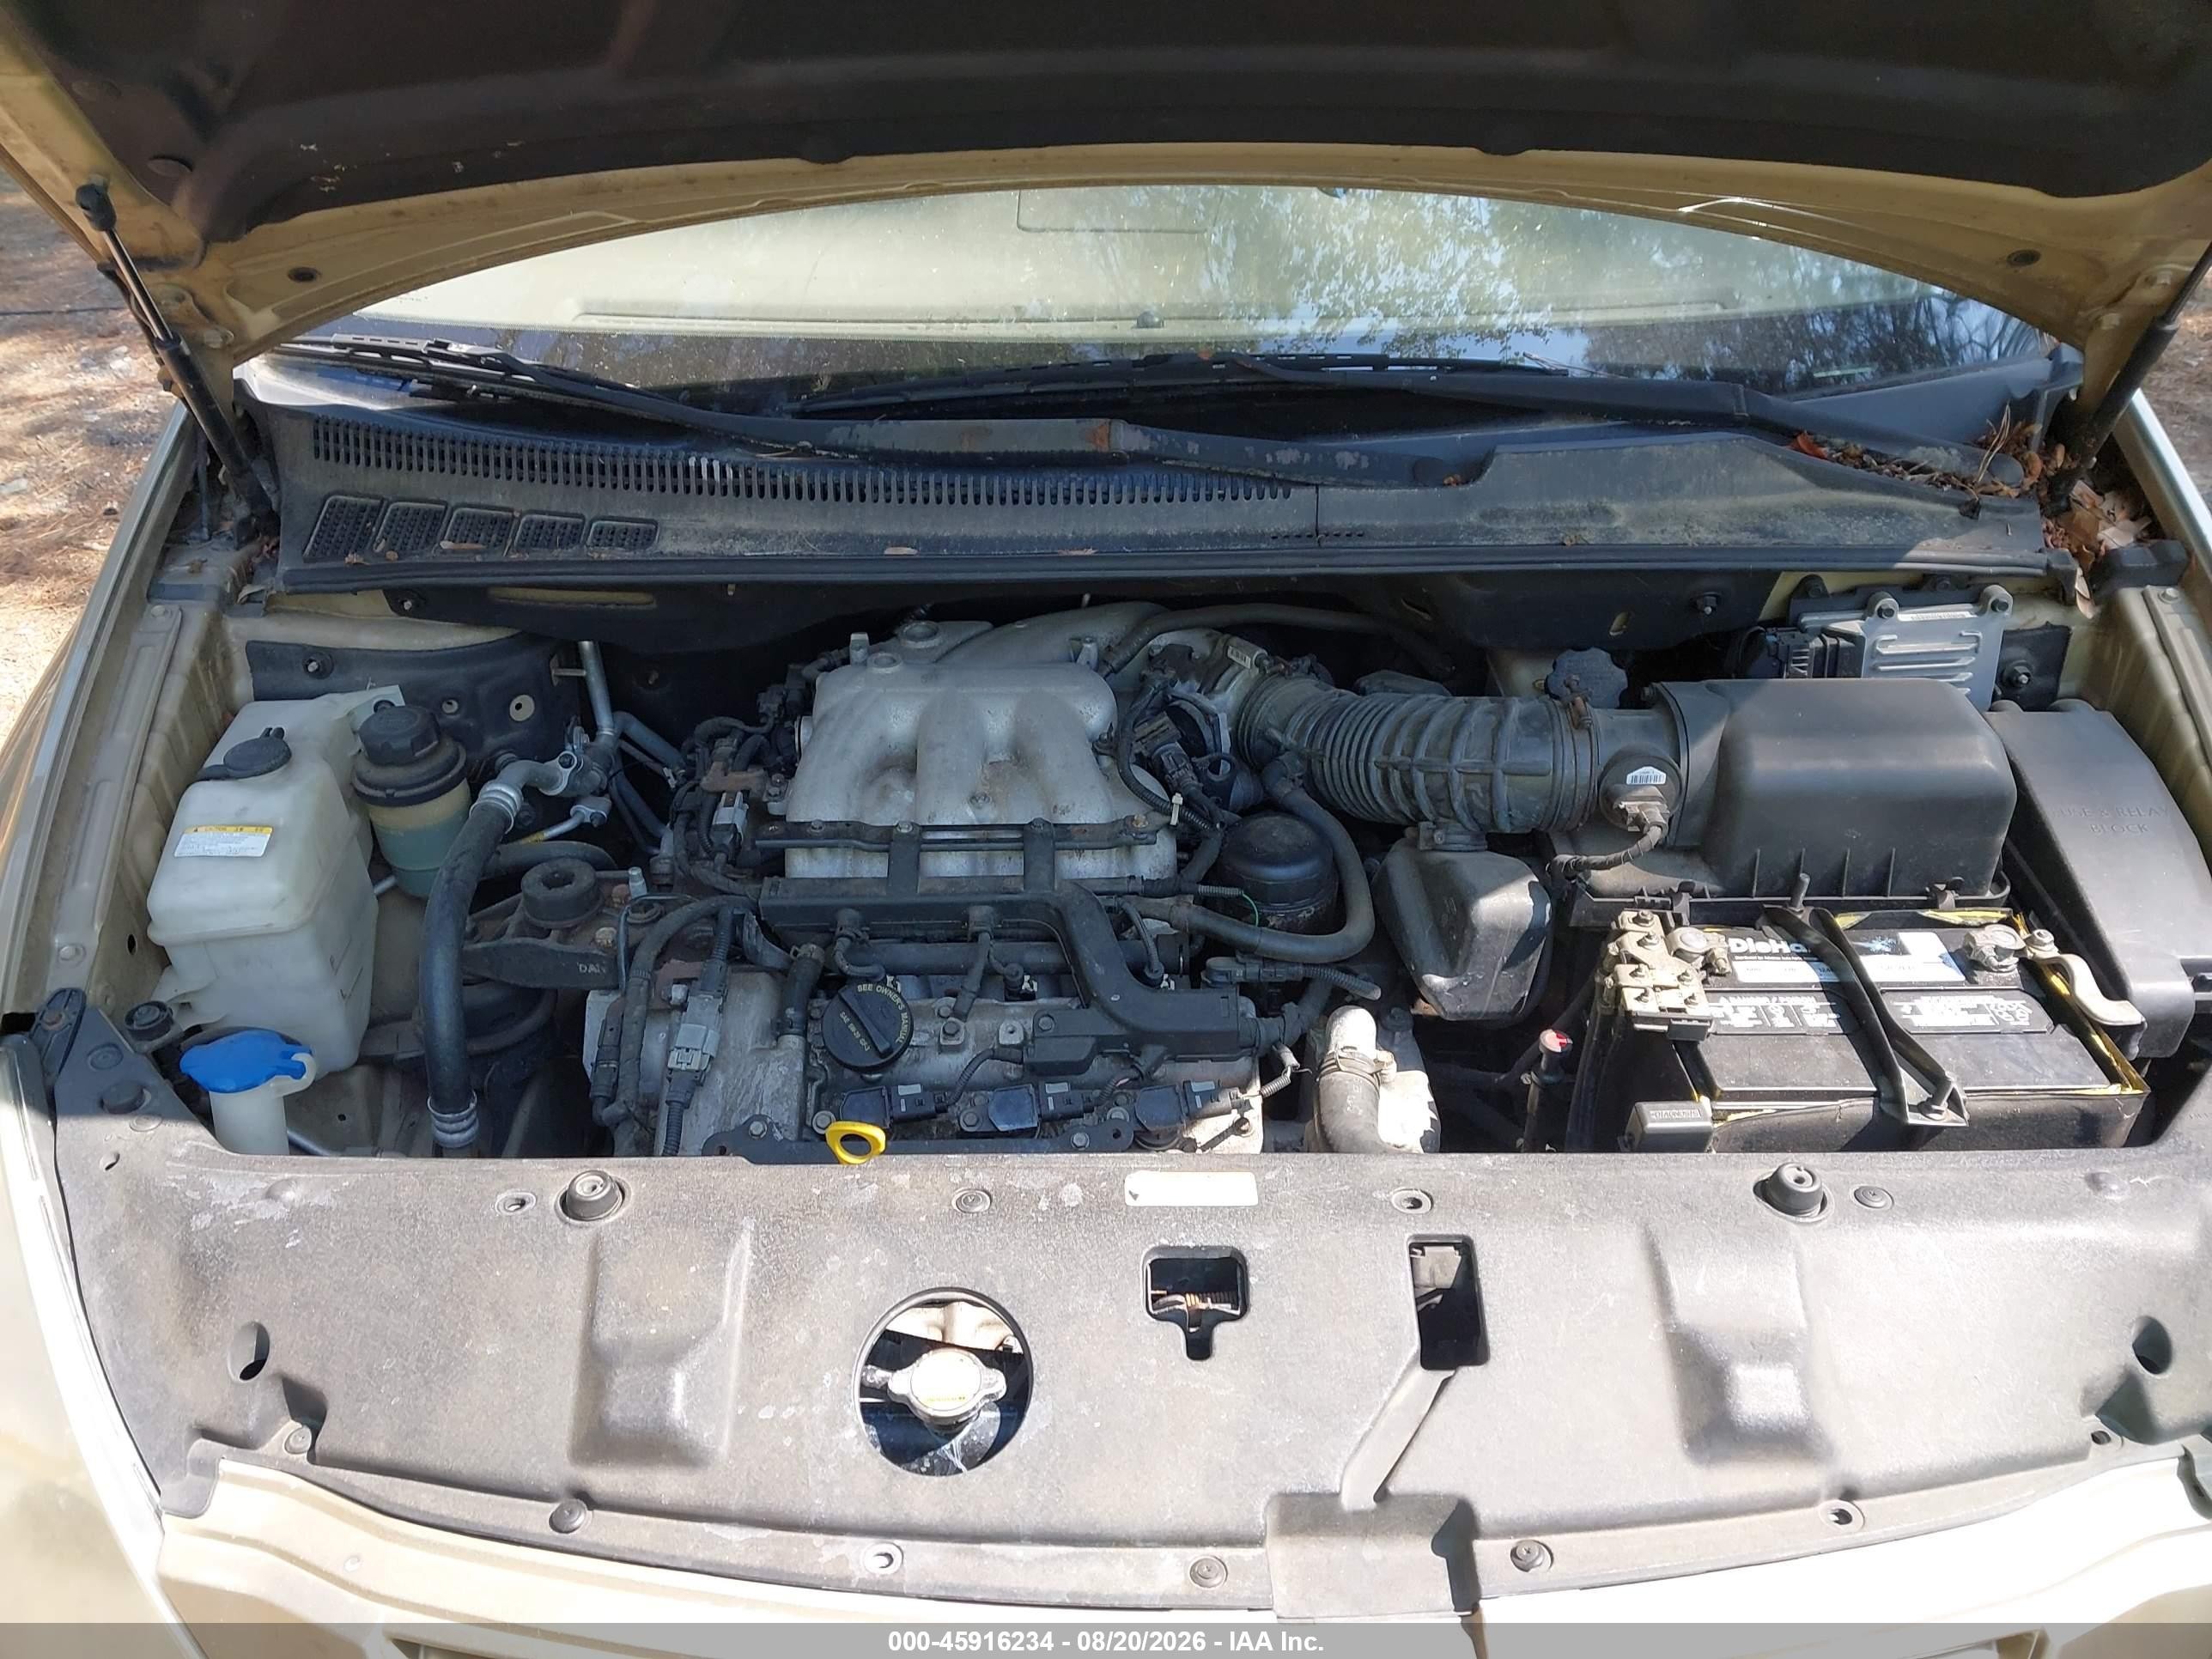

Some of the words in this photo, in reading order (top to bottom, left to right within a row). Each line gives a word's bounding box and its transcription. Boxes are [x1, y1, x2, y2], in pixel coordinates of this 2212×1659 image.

[2115, 806, 2169, 817] RELAY
[2089, 823, 2148, 834] BLOCK
[1729, 937, 1809, 954] DieHa
[857, 983, 873, 993] SEE
[895, 1012, 910, 1044] MANUAL
